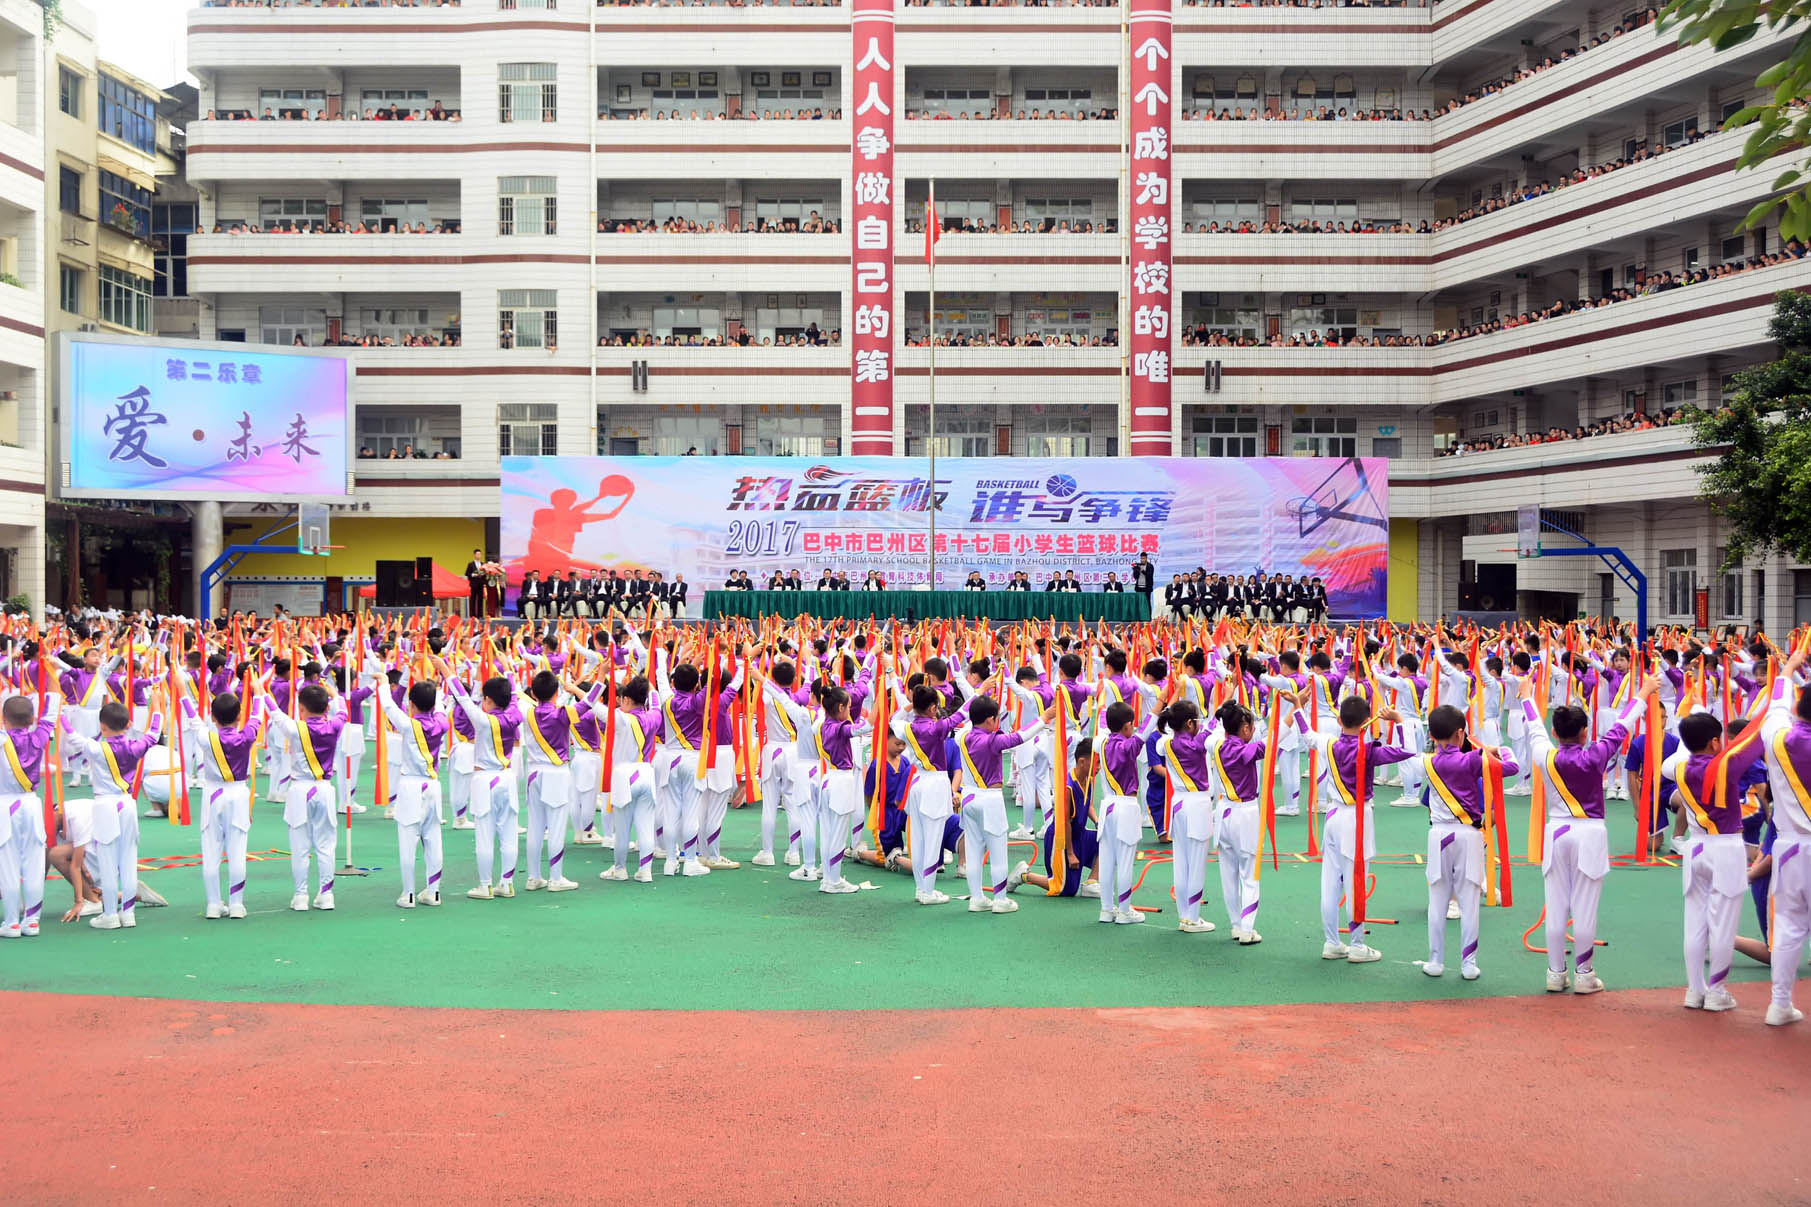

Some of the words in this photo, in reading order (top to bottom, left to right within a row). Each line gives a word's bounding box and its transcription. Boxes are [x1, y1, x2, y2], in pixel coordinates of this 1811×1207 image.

[855, 36, 891, 417] 人人争做自己的第一
[1133, 37, 1170, 417] 个个成为学校的唯一
[166, 358, 263, 385] 第二乐章
[976, 479, 1040, 489] BASKETBALL
[969, 490, 1176, 523] 谁与争锋
[726, 519, 800, 553] 2017
[803, 532, 1159, 554] 巴中市巴州区第十七届小学生篮球比赛
[805, 556, 820, 564] THE
[824, 556, 844, 564] 17TH
[846, 556, 883, 565] PRIMARY
[886, 556, 920, 565] SCHOOL
[977, 557, 1000, 566] GAME
[1004, 557, 1013, 566] IN
[1015, 557, 1051, 566] BAZHOU
